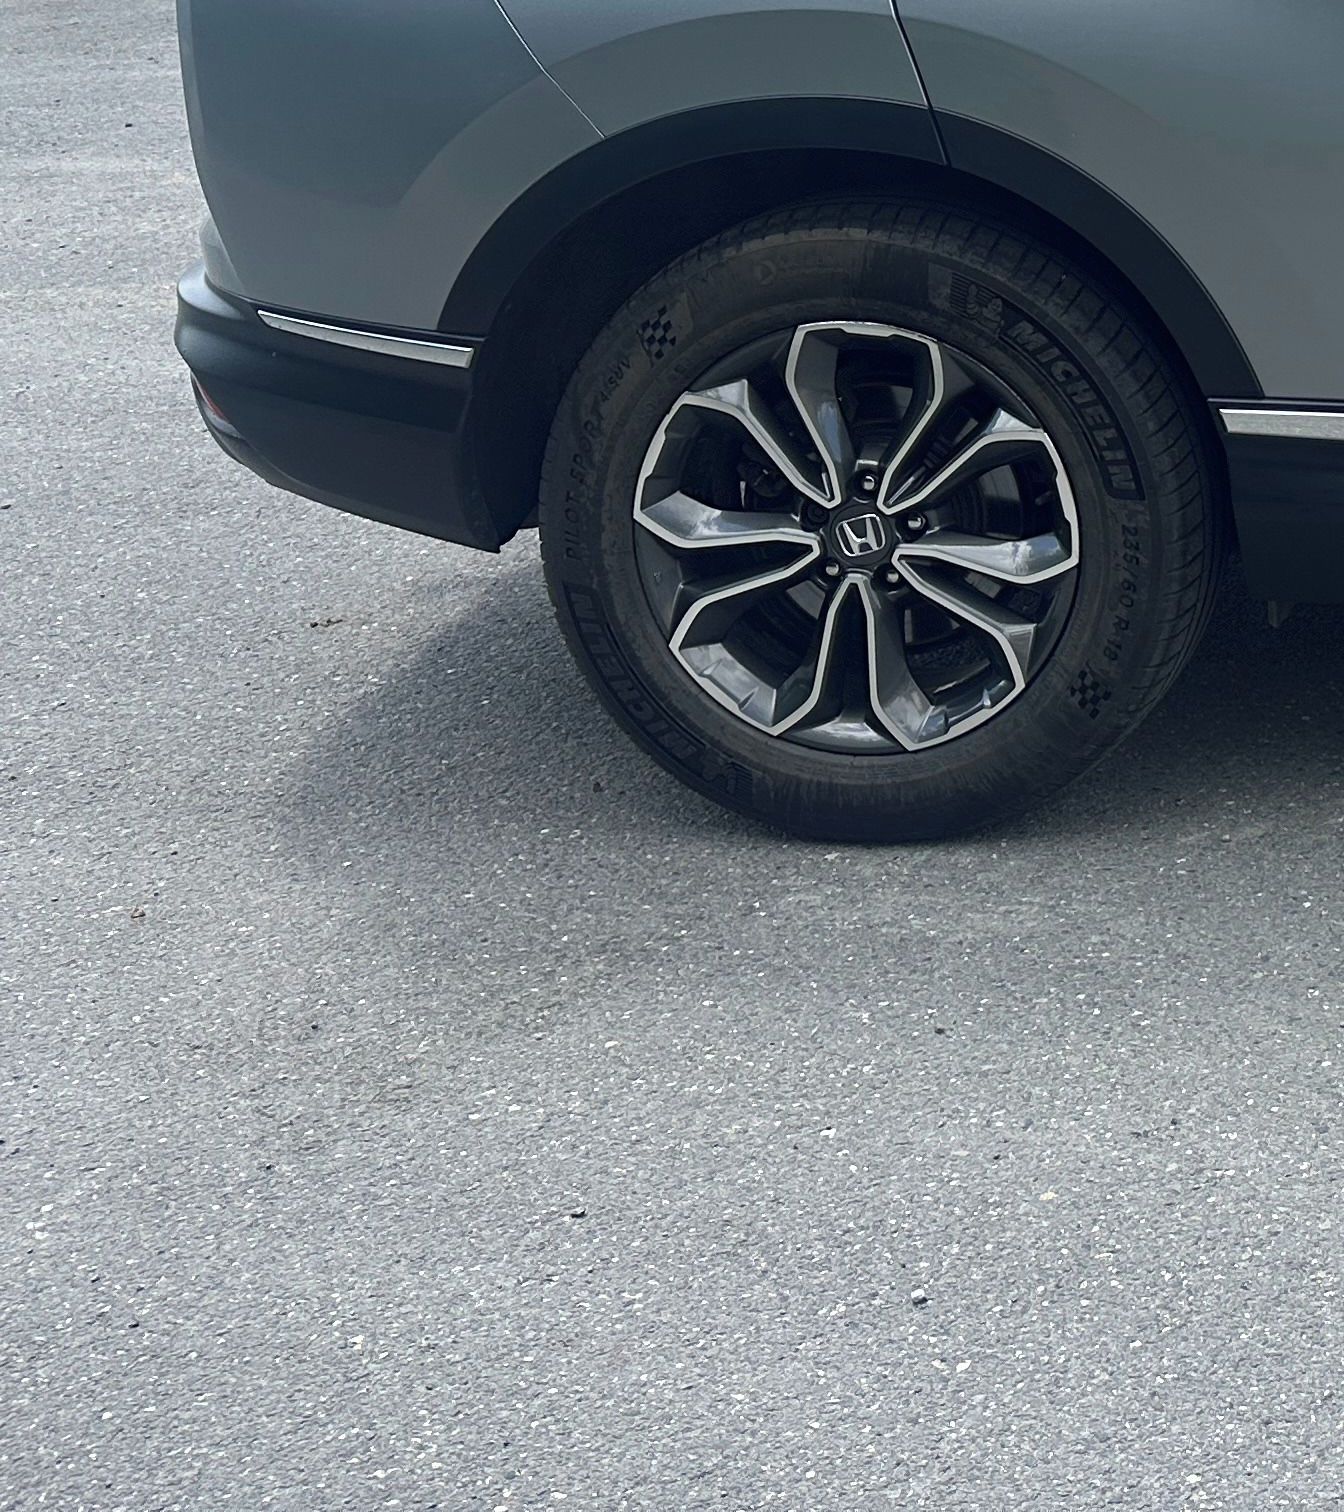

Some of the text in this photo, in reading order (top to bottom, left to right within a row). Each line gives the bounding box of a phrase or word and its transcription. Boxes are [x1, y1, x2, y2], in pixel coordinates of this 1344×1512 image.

[1006, 319, 1137, 491] MICHELIN
[1119, 523, 1142, 609] 235/60
[570, 592, 698, 760] MICHELIN
